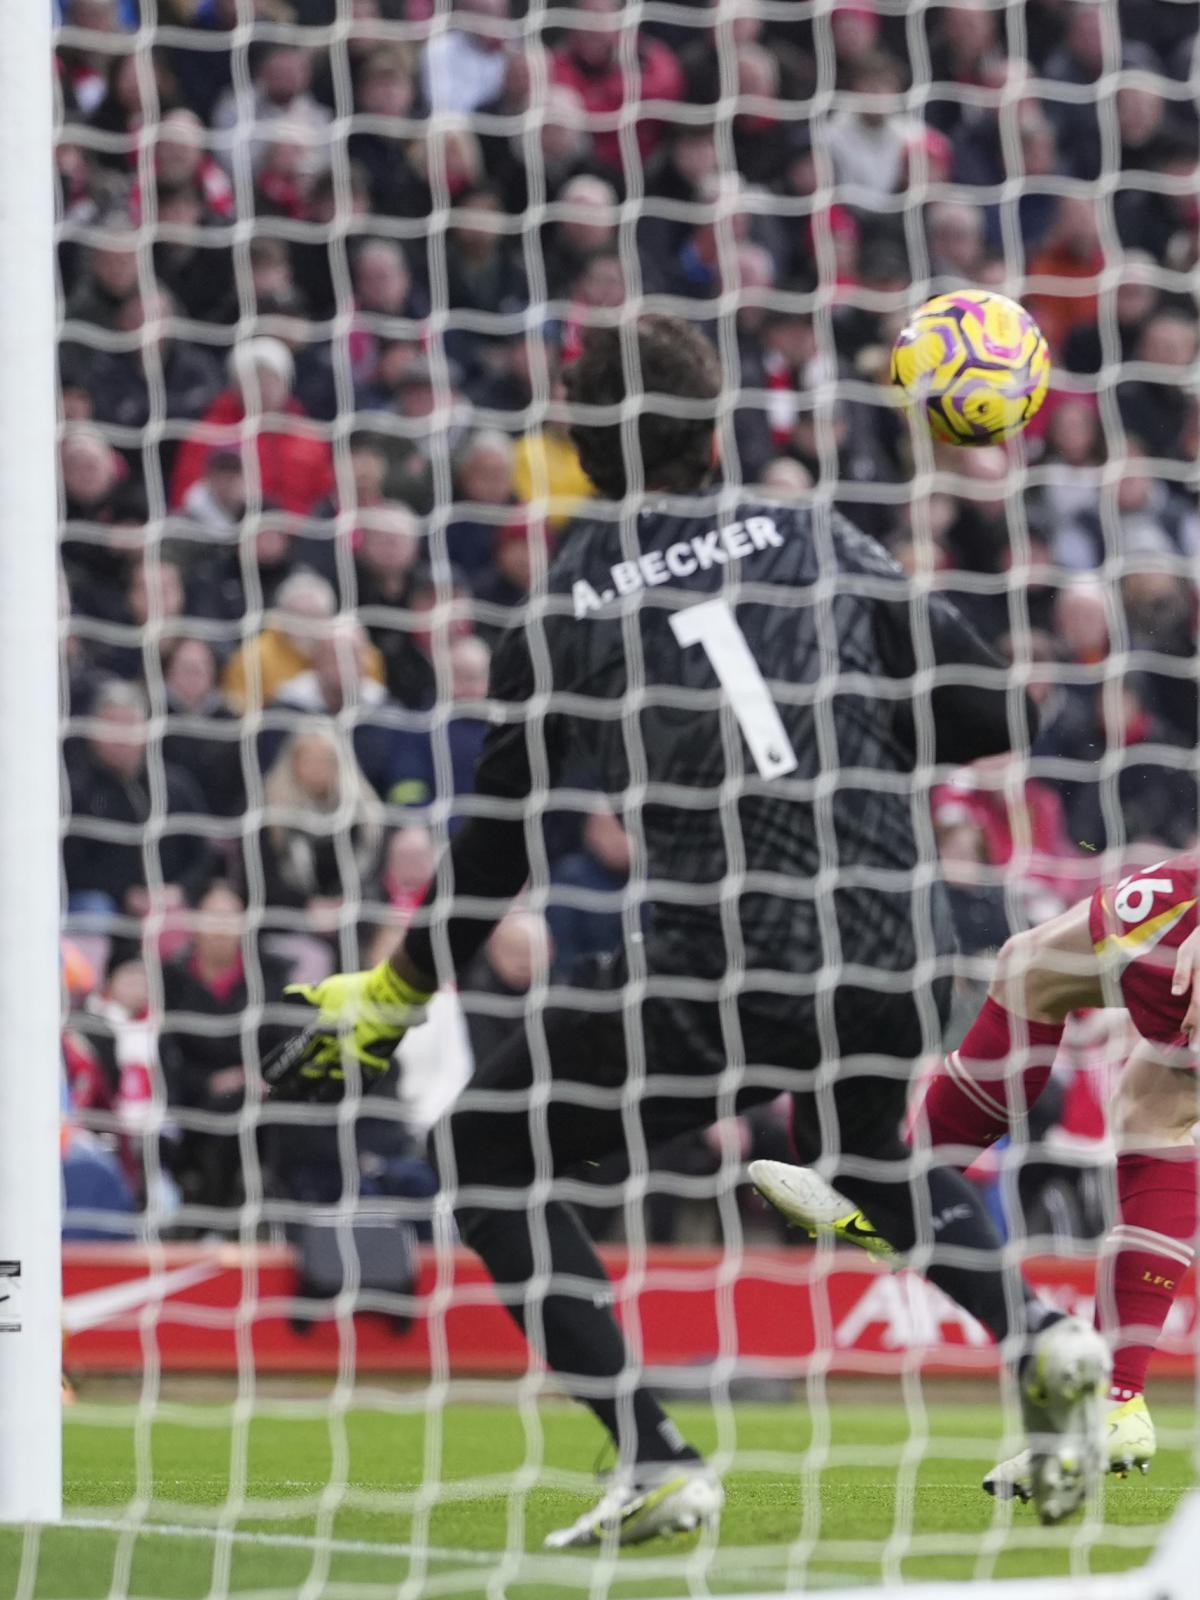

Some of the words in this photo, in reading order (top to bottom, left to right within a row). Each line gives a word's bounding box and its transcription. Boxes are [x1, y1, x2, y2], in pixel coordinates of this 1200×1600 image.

[572, 516, 784, 620] A.BECKER
[668, 598, 799, 781] 1
[1114, 860, 1174, 923] 6
[1142, 1271, 1175, 1290] LFC
